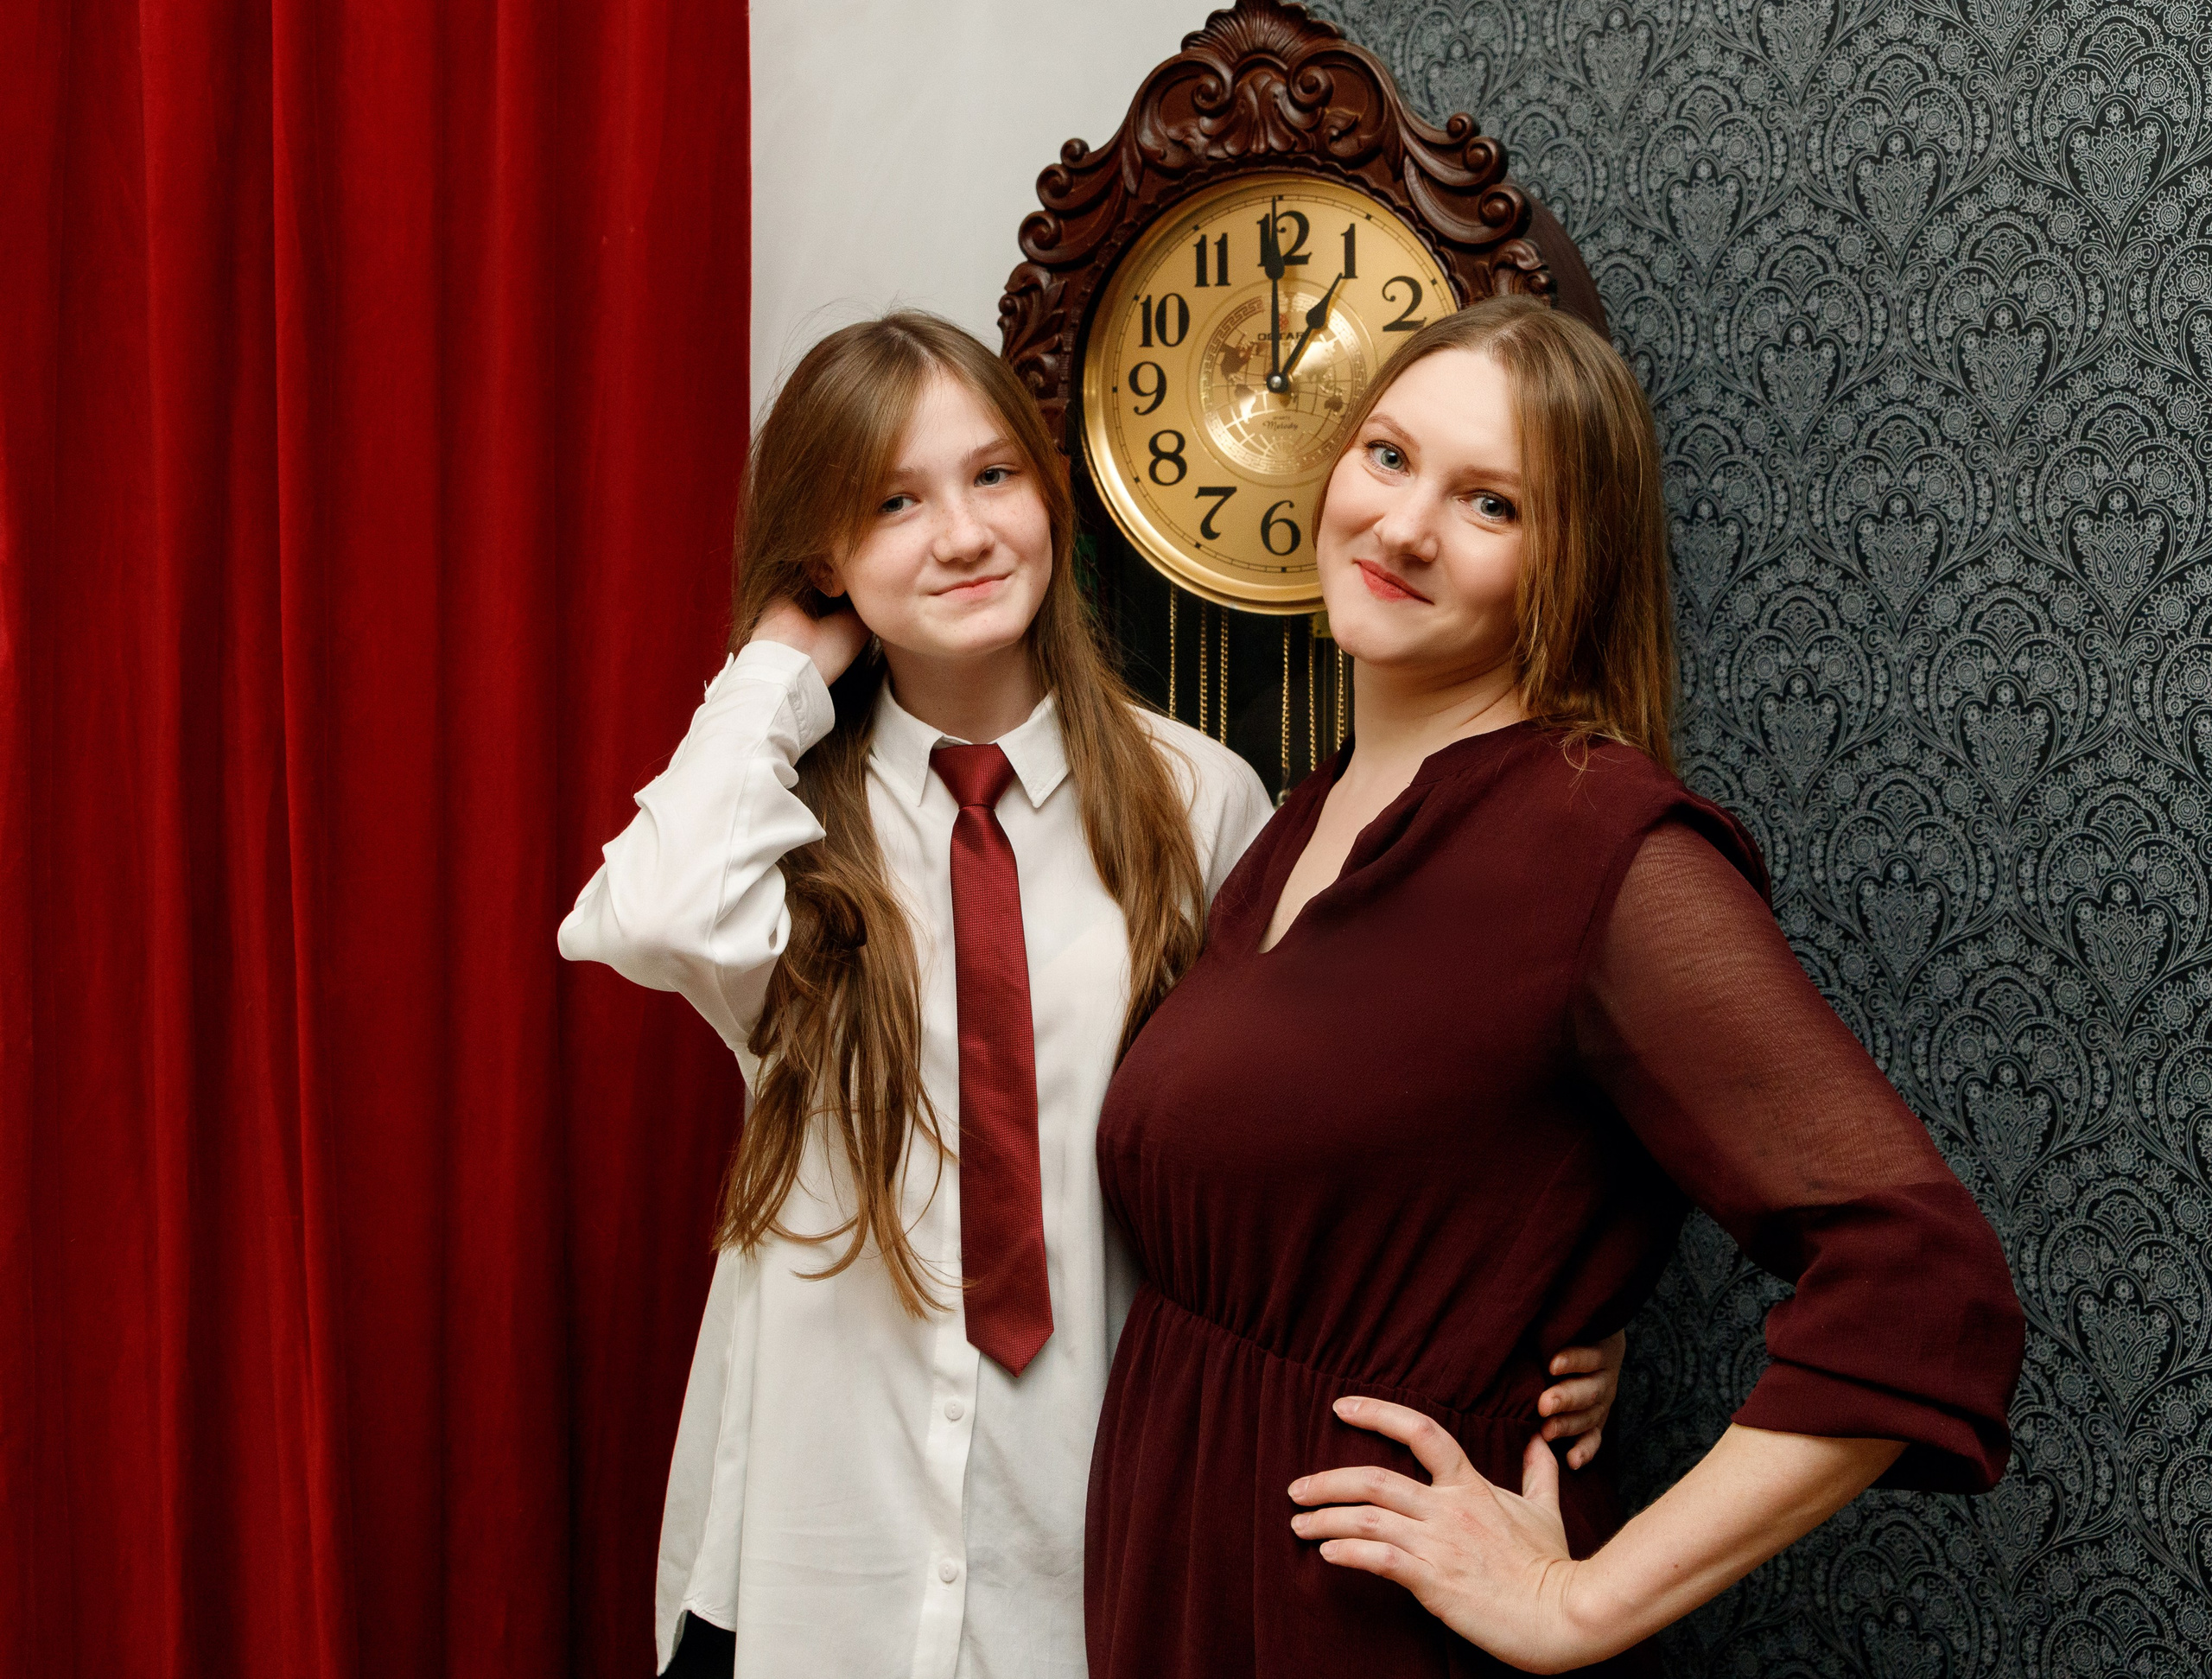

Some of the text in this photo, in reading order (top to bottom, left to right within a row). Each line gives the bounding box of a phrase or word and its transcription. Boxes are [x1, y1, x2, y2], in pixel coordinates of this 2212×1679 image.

[1192, 232, 1232, 288] 11
[1256, 210, 1313, 267] 12
[1340, 223, 1358, 279] 1
[1139, 292, 1191, 347] 10
[1382, 275, 1427, 333] 2
[1128, 361, 1167, 417] 9
[1148, 429, 1188, 486] 8
[1194, 486, 1237, 541] 7
[1260, 499, 1301, 556] 6
